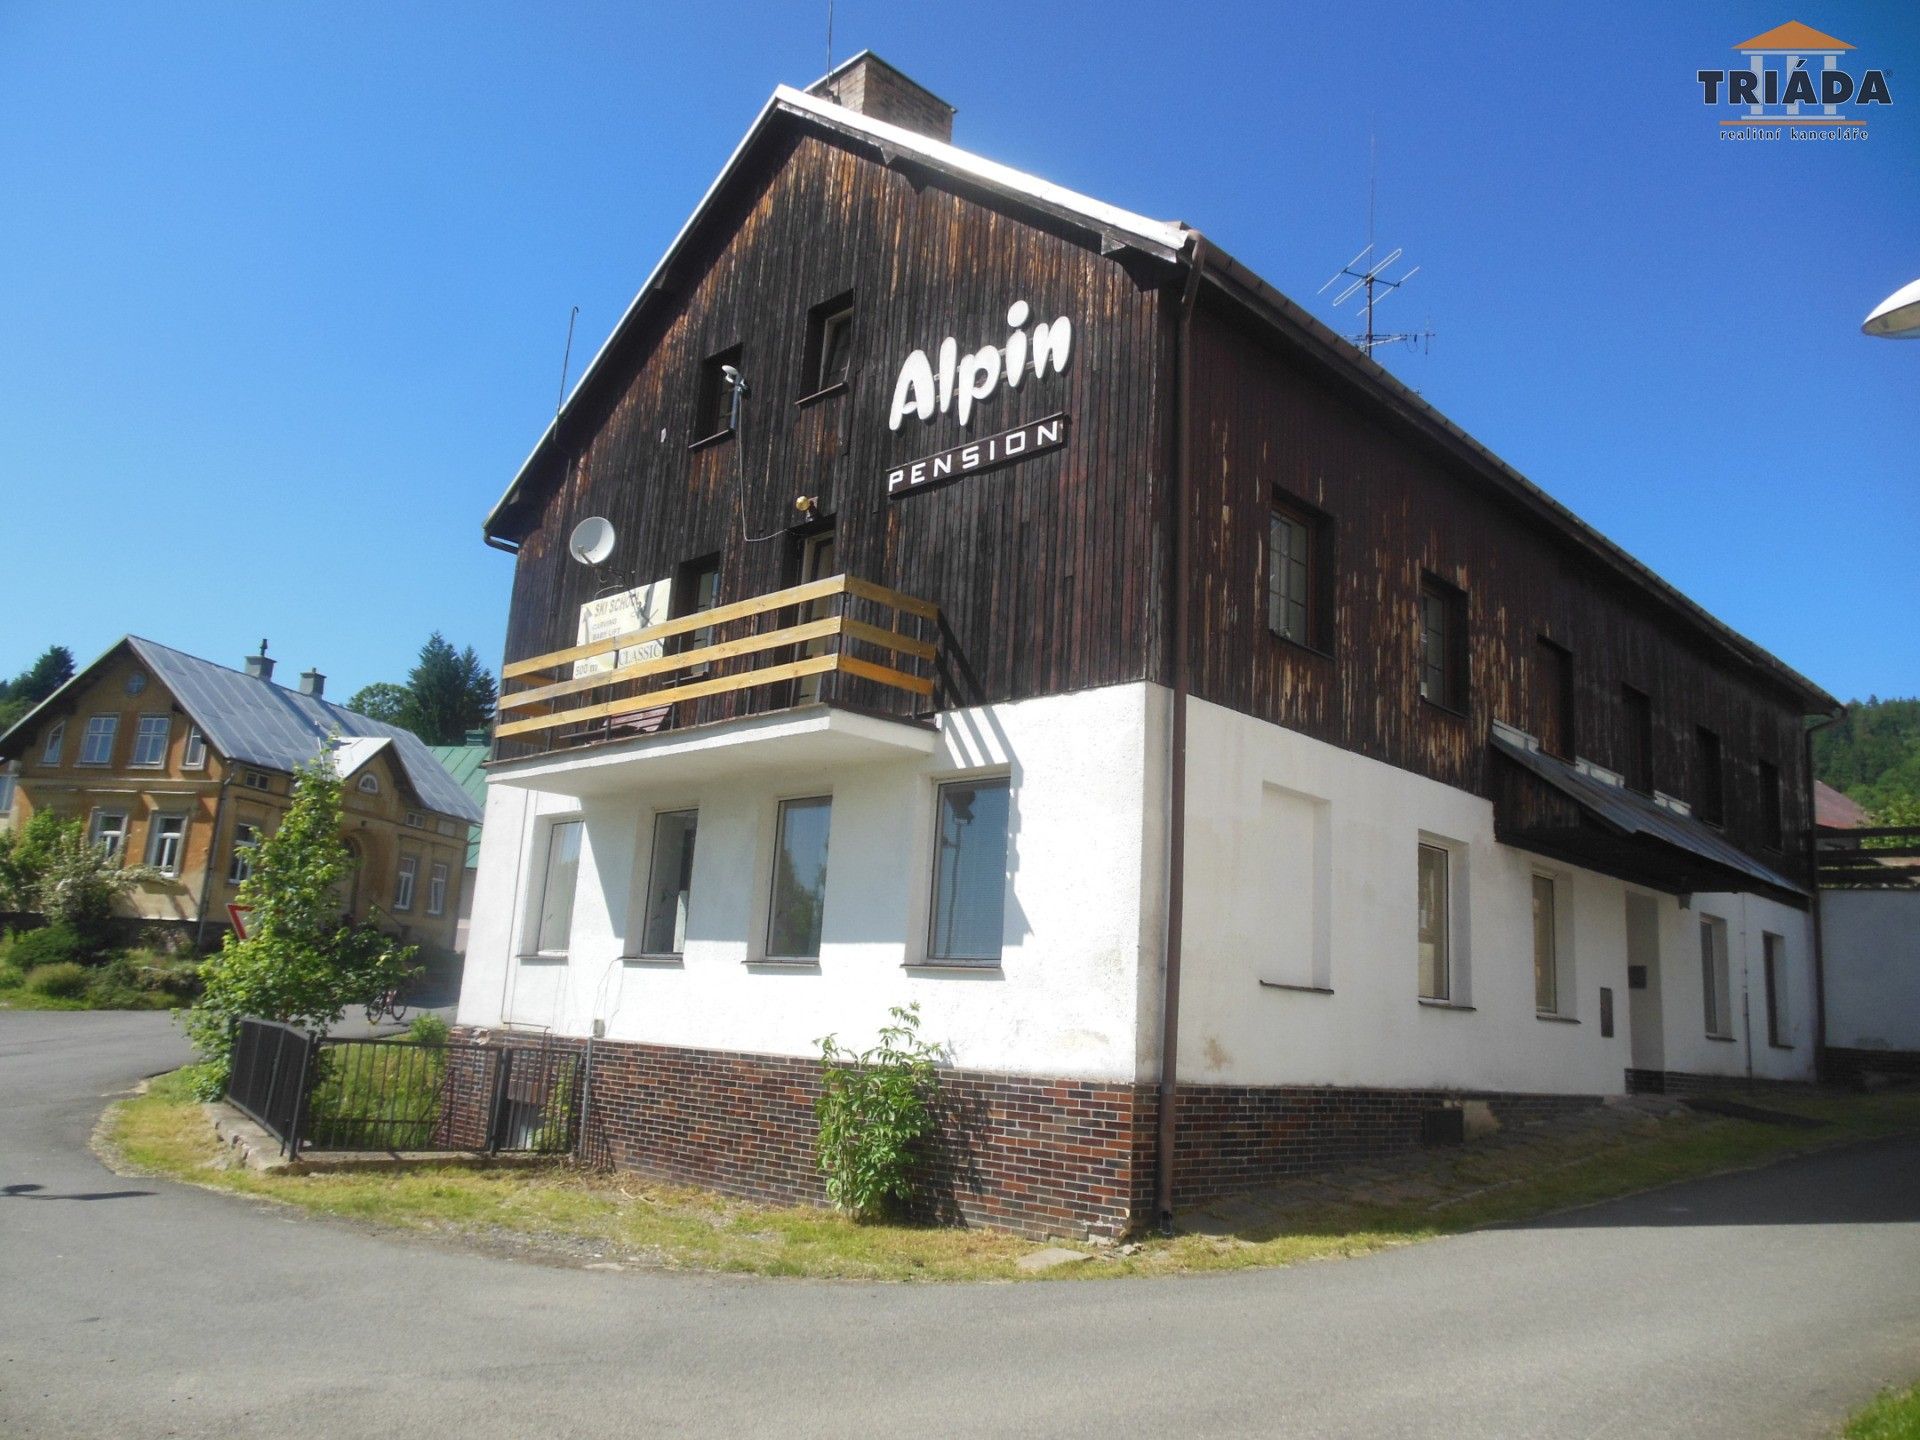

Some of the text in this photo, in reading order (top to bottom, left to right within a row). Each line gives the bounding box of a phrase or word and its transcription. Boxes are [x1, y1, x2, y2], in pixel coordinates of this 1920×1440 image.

[889, 300, 1071, 431] Alpin
[888, 421, 1058, 492] PENSION
[619, 643, 661, 666] CLASSIC
